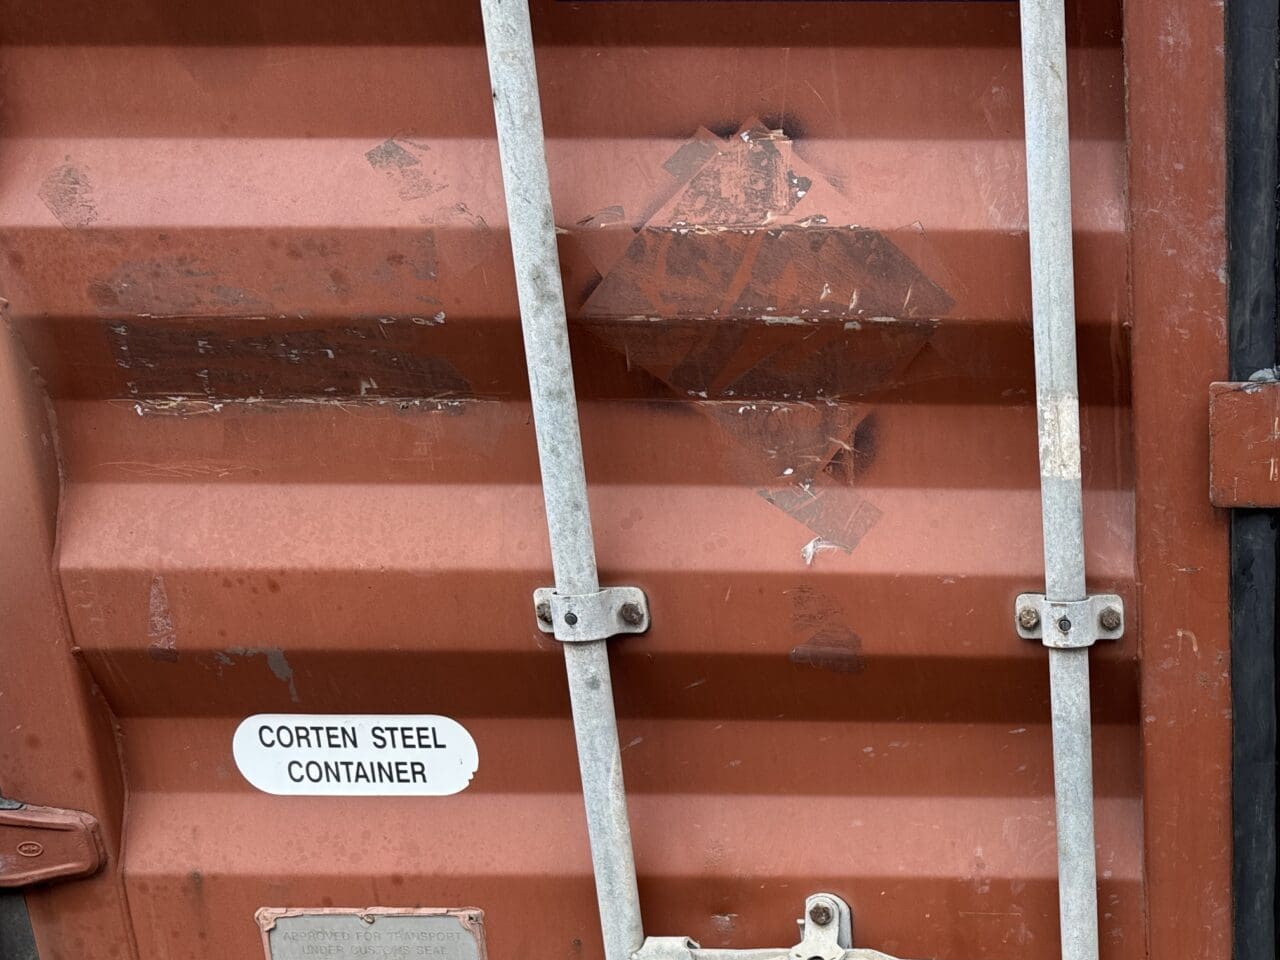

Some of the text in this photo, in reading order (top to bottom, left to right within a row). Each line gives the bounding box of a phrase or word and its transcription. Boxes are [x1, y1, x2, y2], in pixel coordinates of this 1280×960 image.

[258, 725, 447, 749] CORTEN STEEL
[287, 761, 427, 783] CONTAINER
